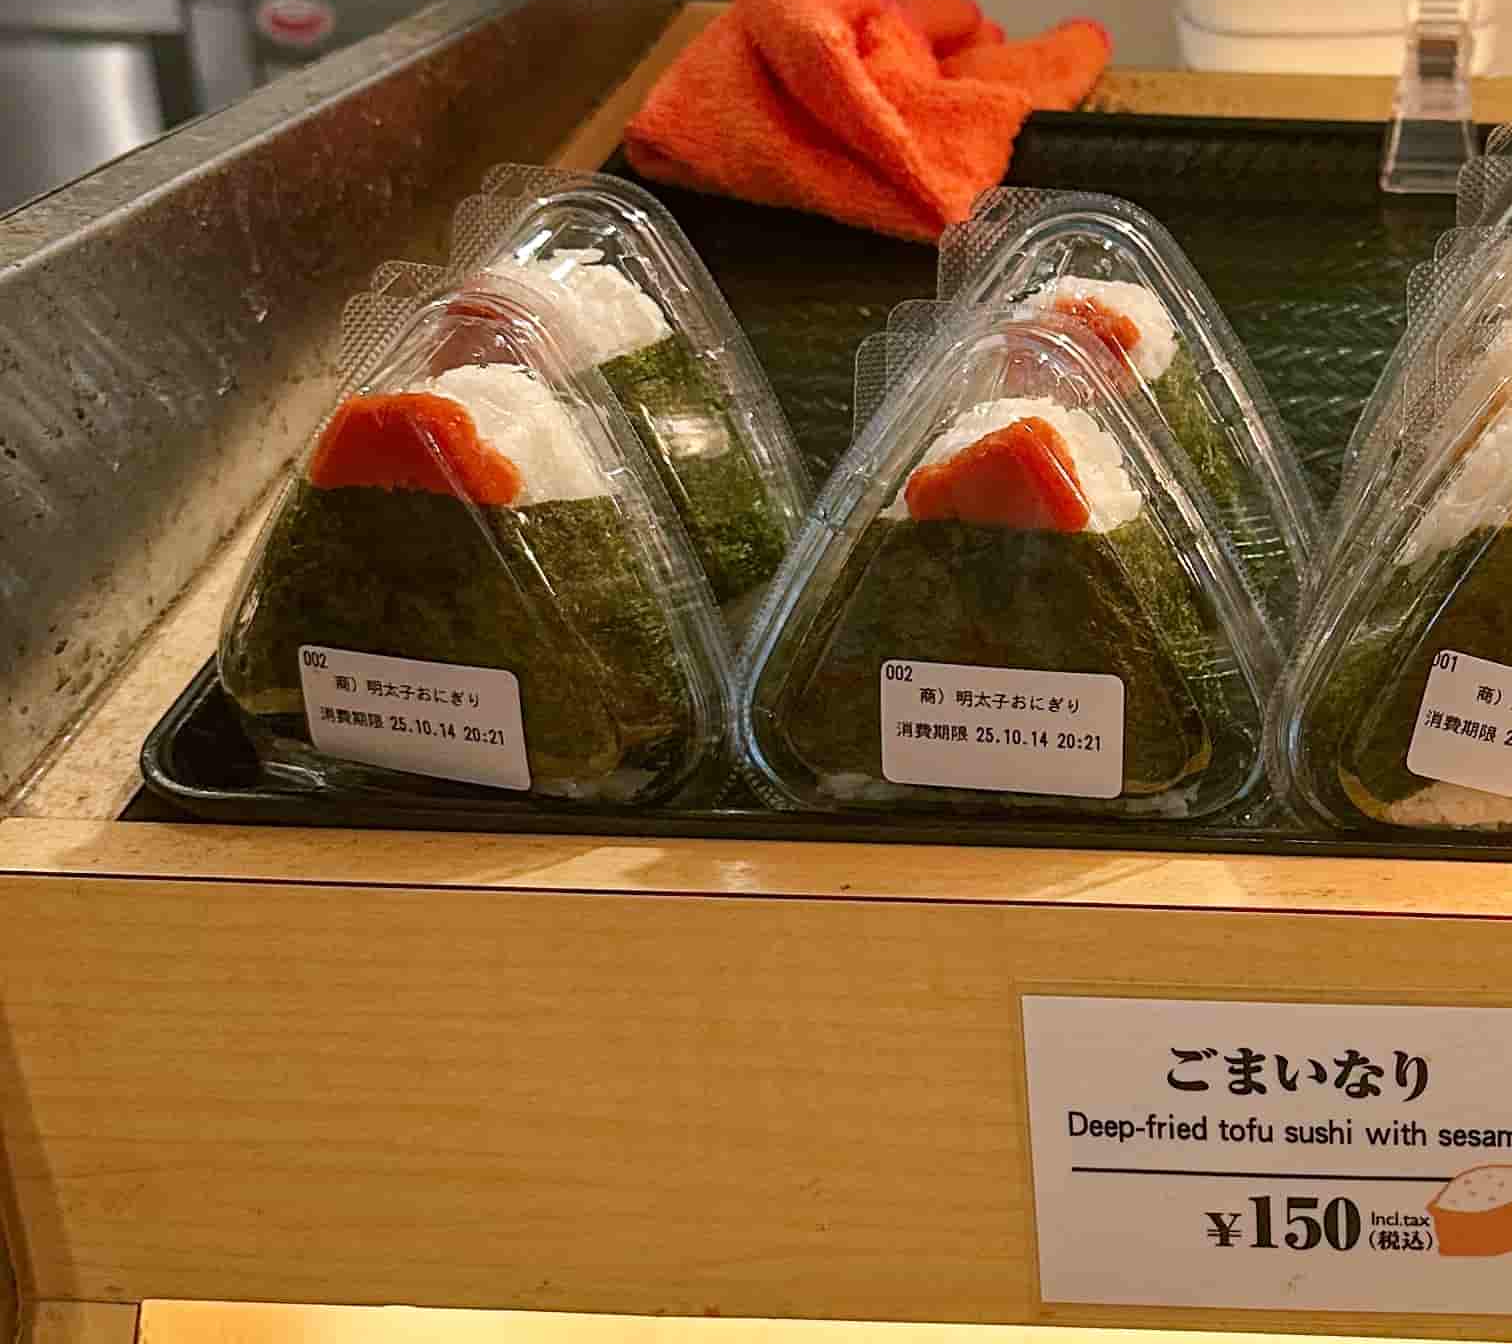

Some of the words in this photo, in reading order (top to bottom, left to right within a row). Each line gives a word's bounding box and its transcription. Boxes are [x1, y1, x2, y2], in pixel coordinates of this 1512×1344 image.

[303, 650, 329, 669] 002
[886, 663, 913, 682] 002
[320, 706, 384, 730] 消費期限
[389, 715, 456, 740] 25.10.14
[463, 725, 506, 746] 20:21
[895, 720, 969, 743] 消費期限
[975, 726, 1049, 749] 25.10.14
[1056, 733, 1102, 753] 20:21
[1423, 709, 1498, 744] 消費期限
[1165, 1045, 1430, 1103] ごまいなり
[1067, 1110, 1208, 1143] Deep-fried
[1218, 1116, 1274, 1144] tofu
[1284, 1118, 1353, 1146] sushi
[1366, 1120, 1428, 1147] with
[1204, 1194, 1362, 1252] ¥150
[1370, 1210, 1430, 1227] Incl.tax
[1368, 1229, 1433, 1251] (税込)
